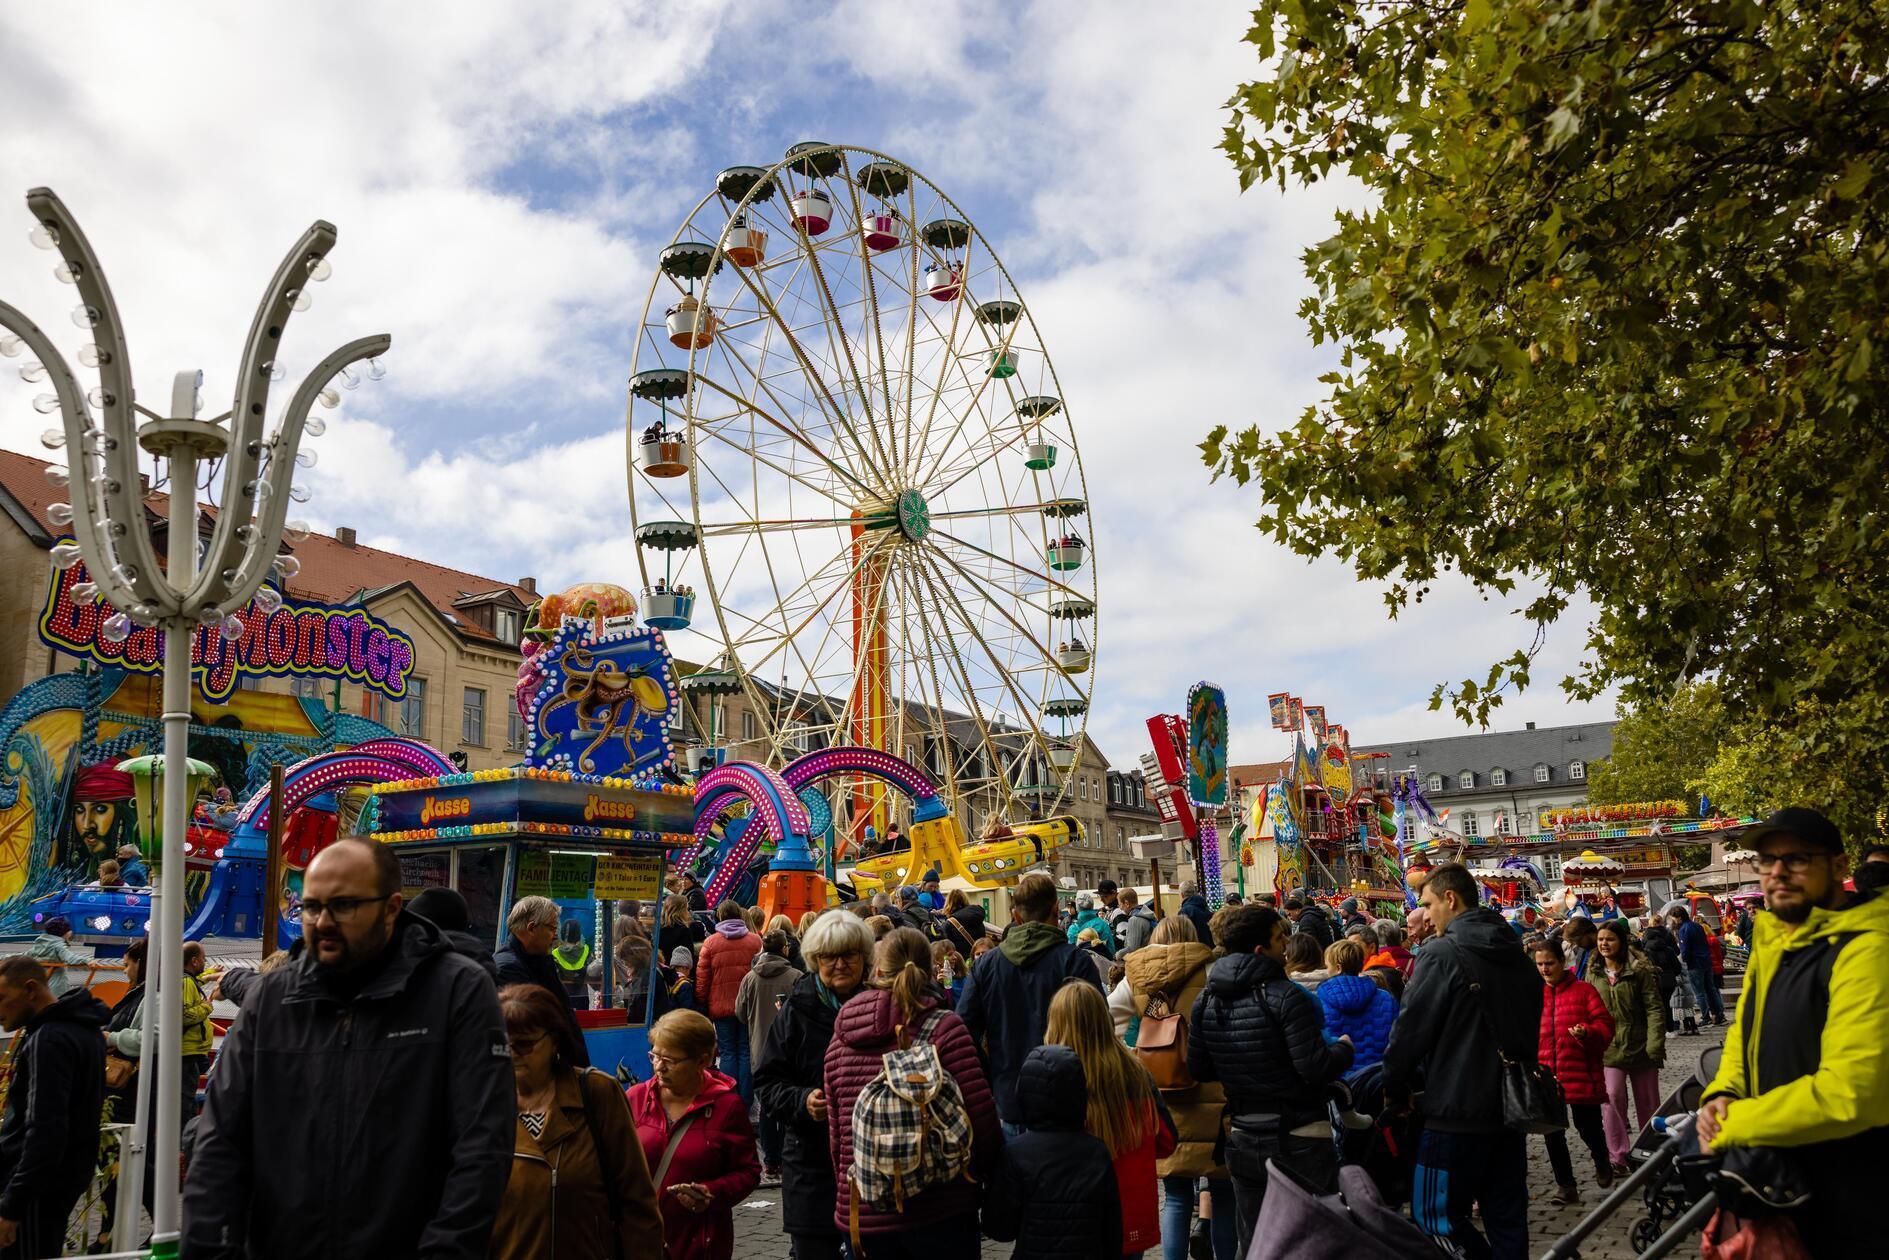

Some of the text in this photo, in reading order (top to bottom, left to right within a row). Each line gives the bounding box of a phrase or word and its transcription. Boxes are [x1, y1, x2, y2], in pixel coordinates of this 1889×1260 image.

[49, 548, 413, 692] BeaMonster
[421, 796, 470, 824] Kasse
[584, 794, 636, 821] Kasse
[1549, 800, 1678, 825] TRAUMFLUG
